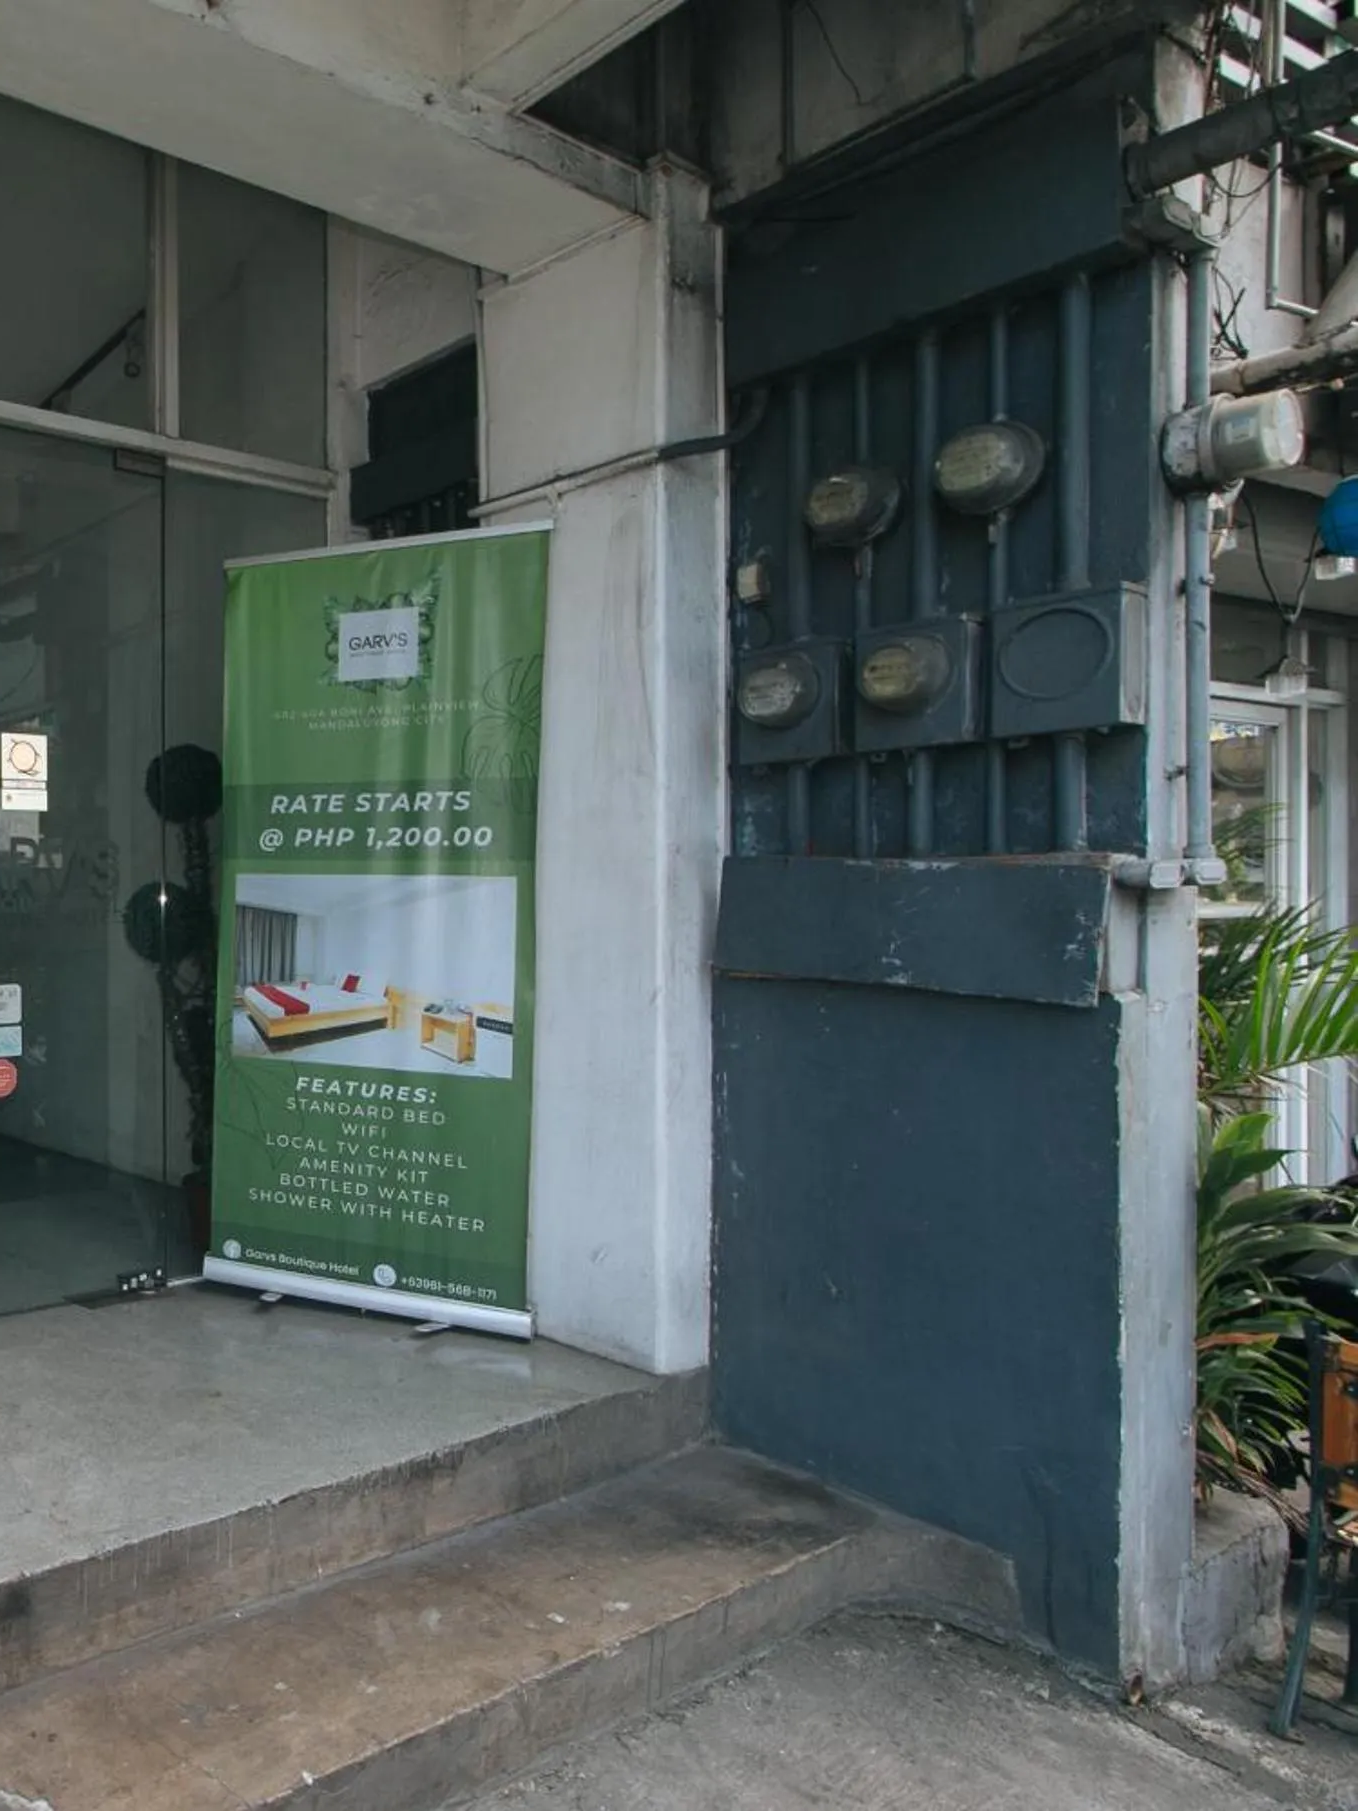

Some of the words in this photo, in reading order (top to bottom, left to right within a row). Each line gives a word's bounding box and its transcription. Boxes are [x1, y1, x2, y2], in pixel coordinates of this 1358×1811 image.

[349, 632, 408, 651] GARV'S
[270, 792, 346, 815] RATE
[355, 790, 472, 813] STARTS
[259, 828, 283, 851] @
[294, 828, 355, 848] PHP
[365, 826, 493, 850] 1,200.00
[296, 1076, 438, 1104] FEATURES:
[285, 1098, 394, 1121] STANDARD
[403, 1109, 446, 1126] BED
[340, 1123, 388, 1139] WIFI
[266, 1133, 328, 1153] LOCAL
[337, 1140, 359, 1156] TV
[368, 1145, 469, 1170] CHANNEL
[299, 1156, 388, 1179] AMENITY
[397, 1168, 429, 1184] KIT
[280, 1172, 369, 1196] BOTTLED
[378, 1186, 450, 1208] WATER
[248, 1188, 332, 1211] SHOWER
[340, 1201, 392, 1220] WITH
[401, 1211, 486, 1233] HEATER
[245, 1248, 276, 1262] Garvs
[278, 1253, 327, 1271] Boutique
[329, 1262, 360, 1276] Hotel
